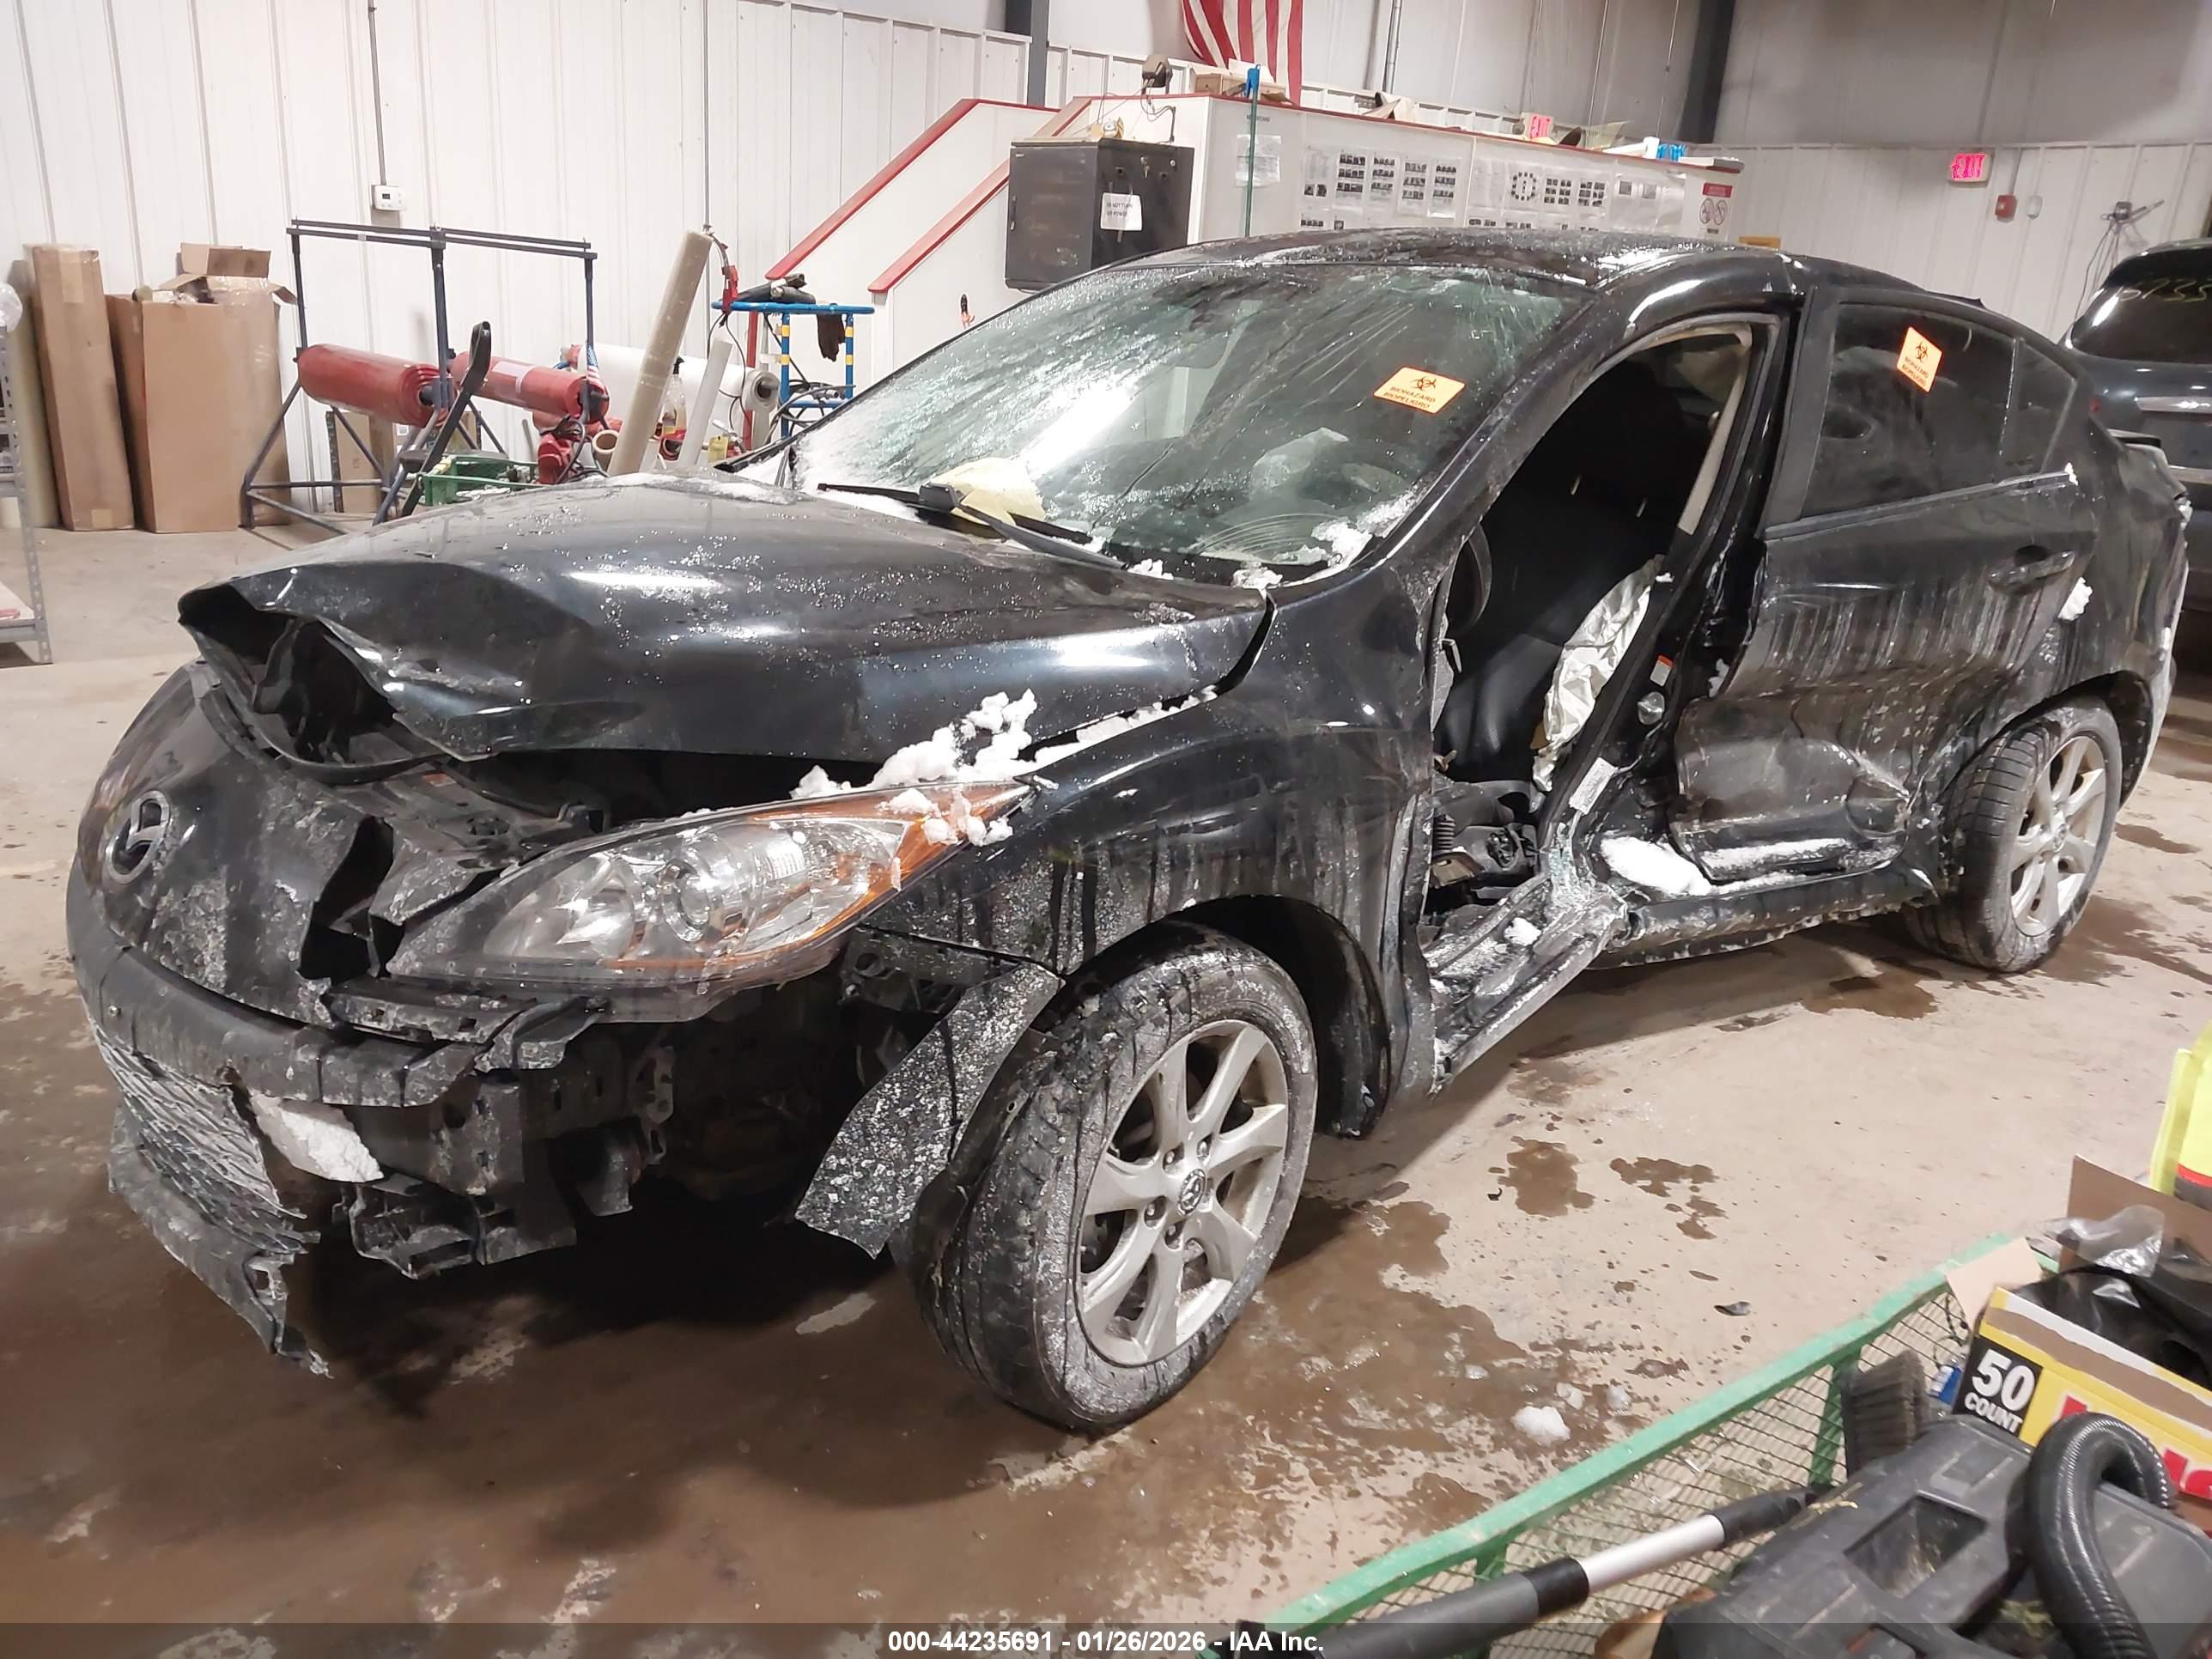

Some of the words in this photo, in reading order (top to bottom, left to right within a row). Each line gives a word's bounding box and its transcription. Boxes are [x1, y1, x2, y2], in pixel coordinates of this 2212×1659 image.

[1905, 356, 1929, 378] BIOHAZARD
[1382, 392, 1431, 409] BIOPELIGRO
[1389, 386, 1436, 403] BIOHAZARD
[1972, 1349, 2035, 1412] 50
[1964, 1392, 2023, 1433] COUNT
